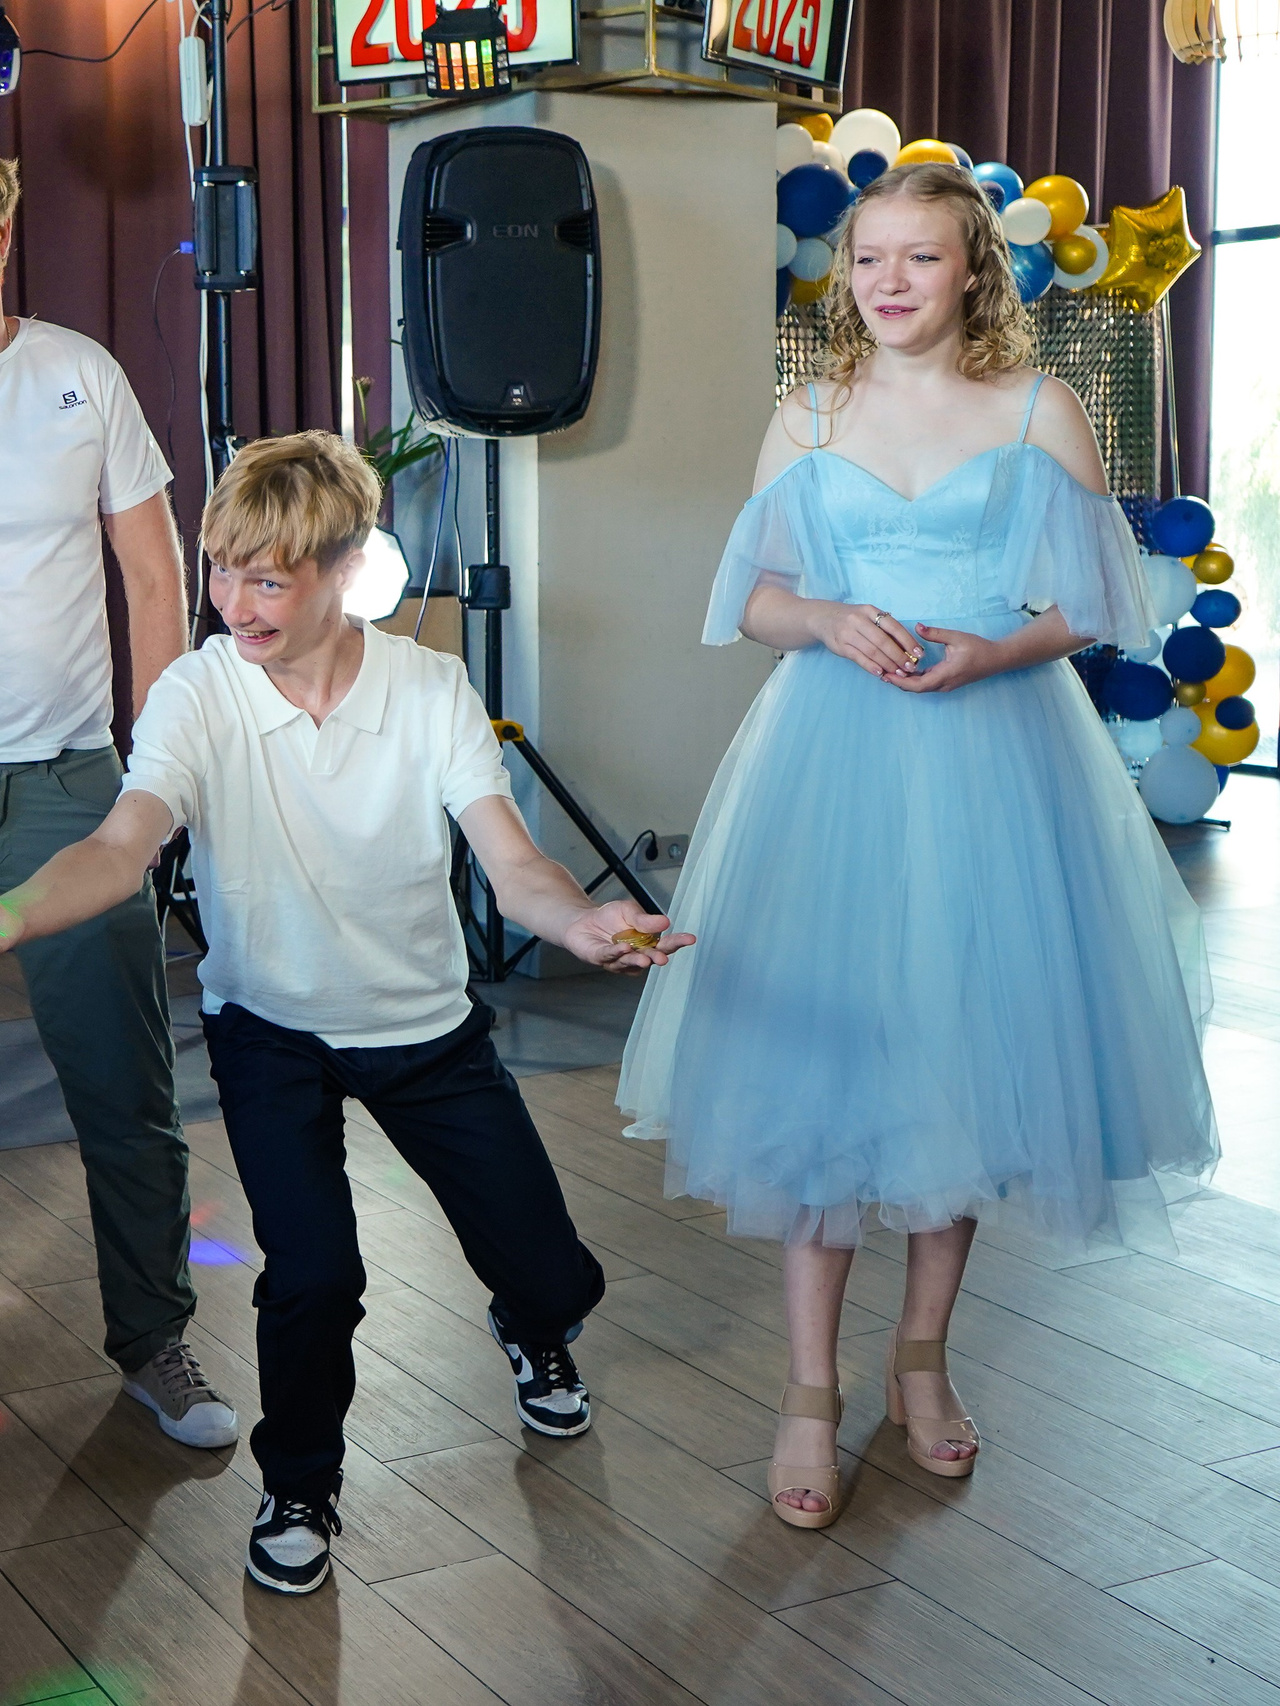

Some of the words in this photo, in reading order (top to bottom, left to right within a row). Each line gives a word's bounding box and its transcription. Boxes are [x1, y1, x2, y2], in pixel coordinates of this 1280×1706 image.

[351, 0, 537, 66] 205
[733, 0, 821, 68] 2025
[492, 223, 539, 239] EON
